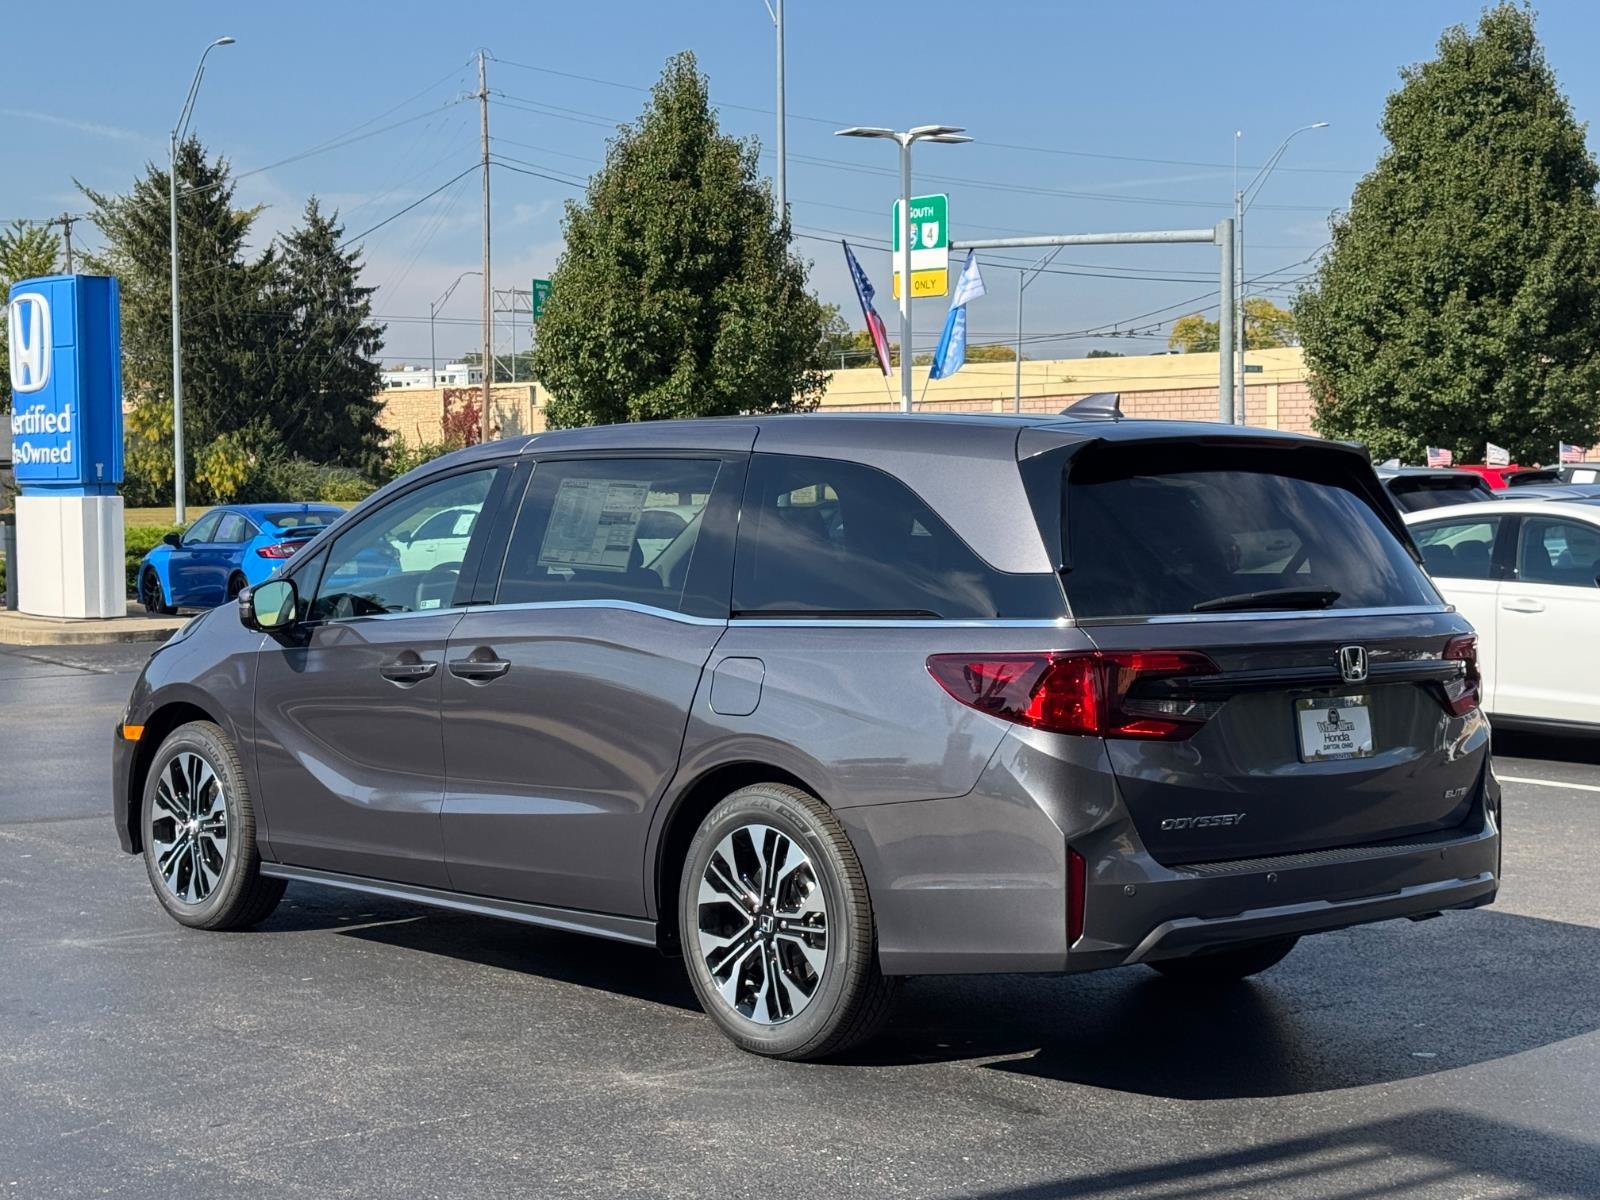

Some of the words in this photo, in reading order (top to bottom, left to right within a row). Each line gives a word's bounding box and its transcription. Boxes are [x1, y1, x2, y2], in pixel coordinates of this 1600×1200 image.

[926, 227, 934, 240] 4
[914, 279, 936, 290] ONLY
[1324, 731, 1350, 743] Honda
[1161, 813, 1247, 831] ODYSSEY
